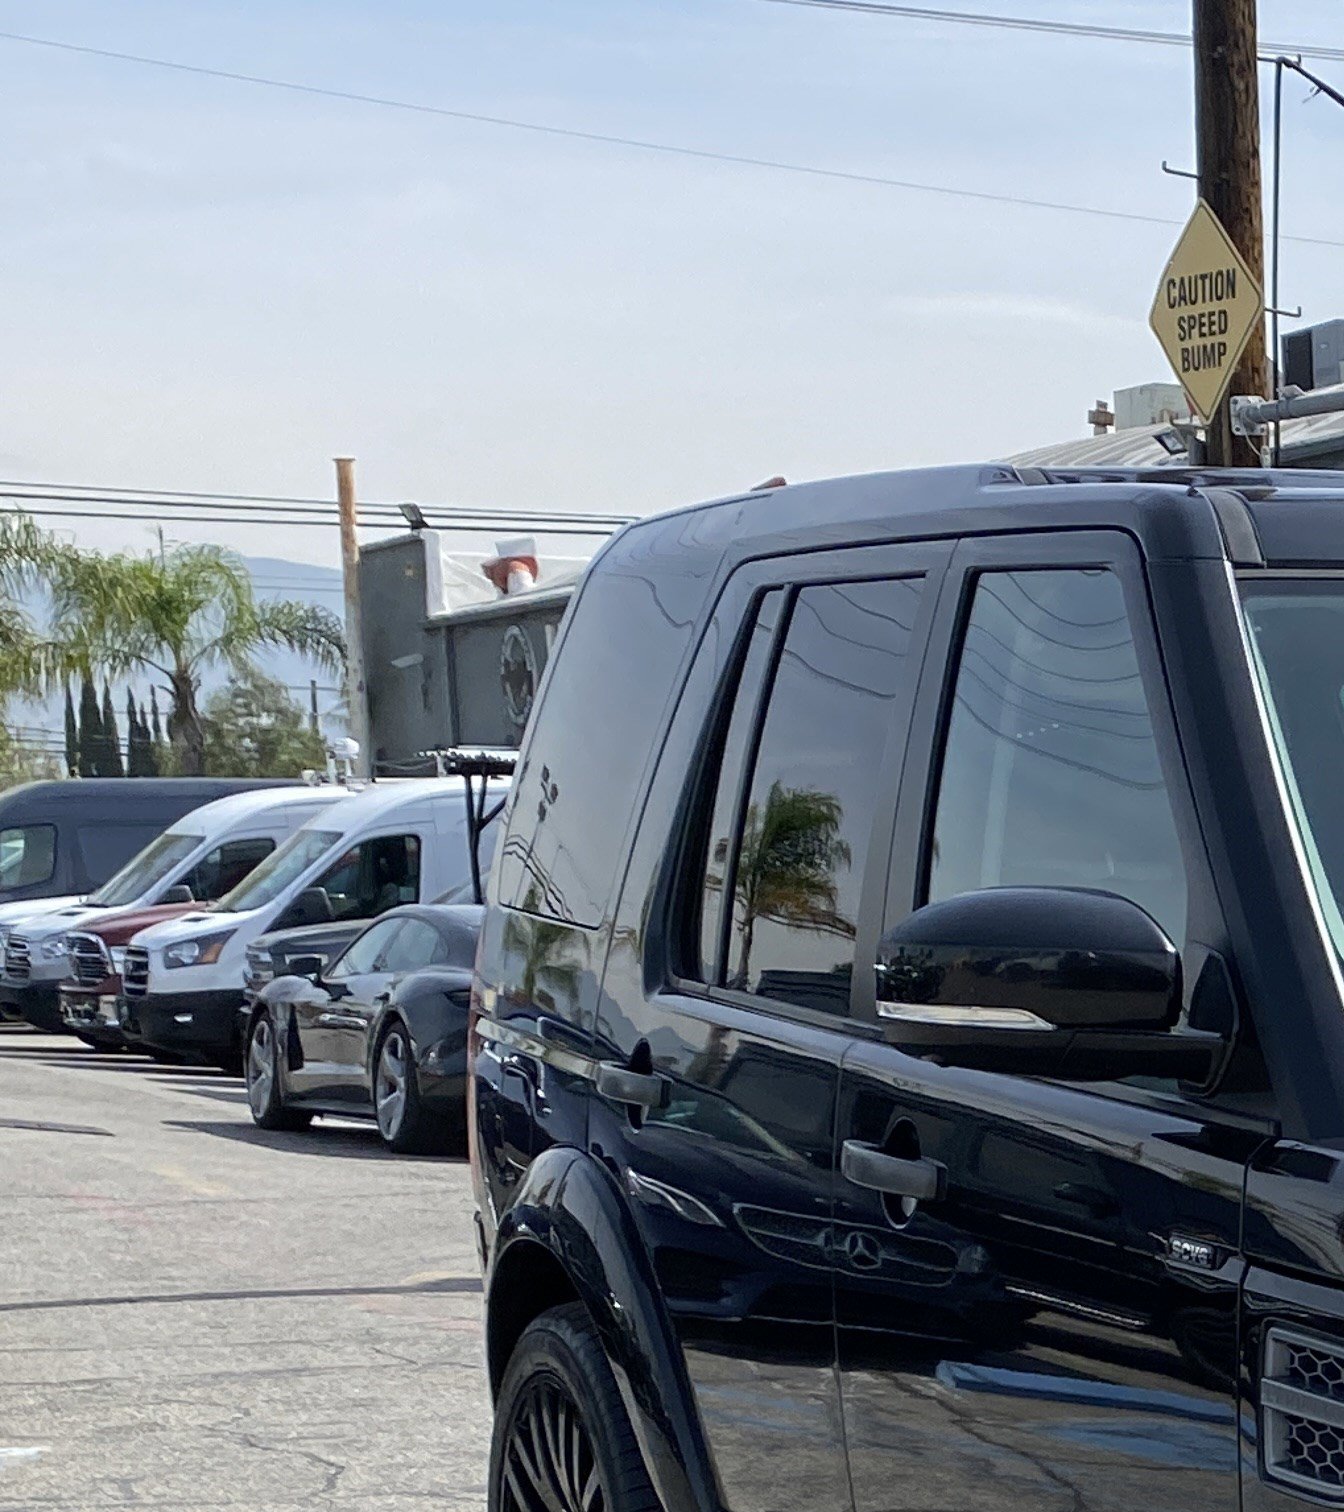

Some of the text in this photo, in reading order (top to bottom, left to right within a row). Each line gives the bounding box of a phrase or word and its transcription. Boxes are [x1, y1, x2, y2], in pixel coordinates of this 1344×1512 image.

[1167, 268, 1236, 309] CAUTION
[1177, 309, 1228, 341] SPEED
[1181, 342, 1227, 373] BUMP
